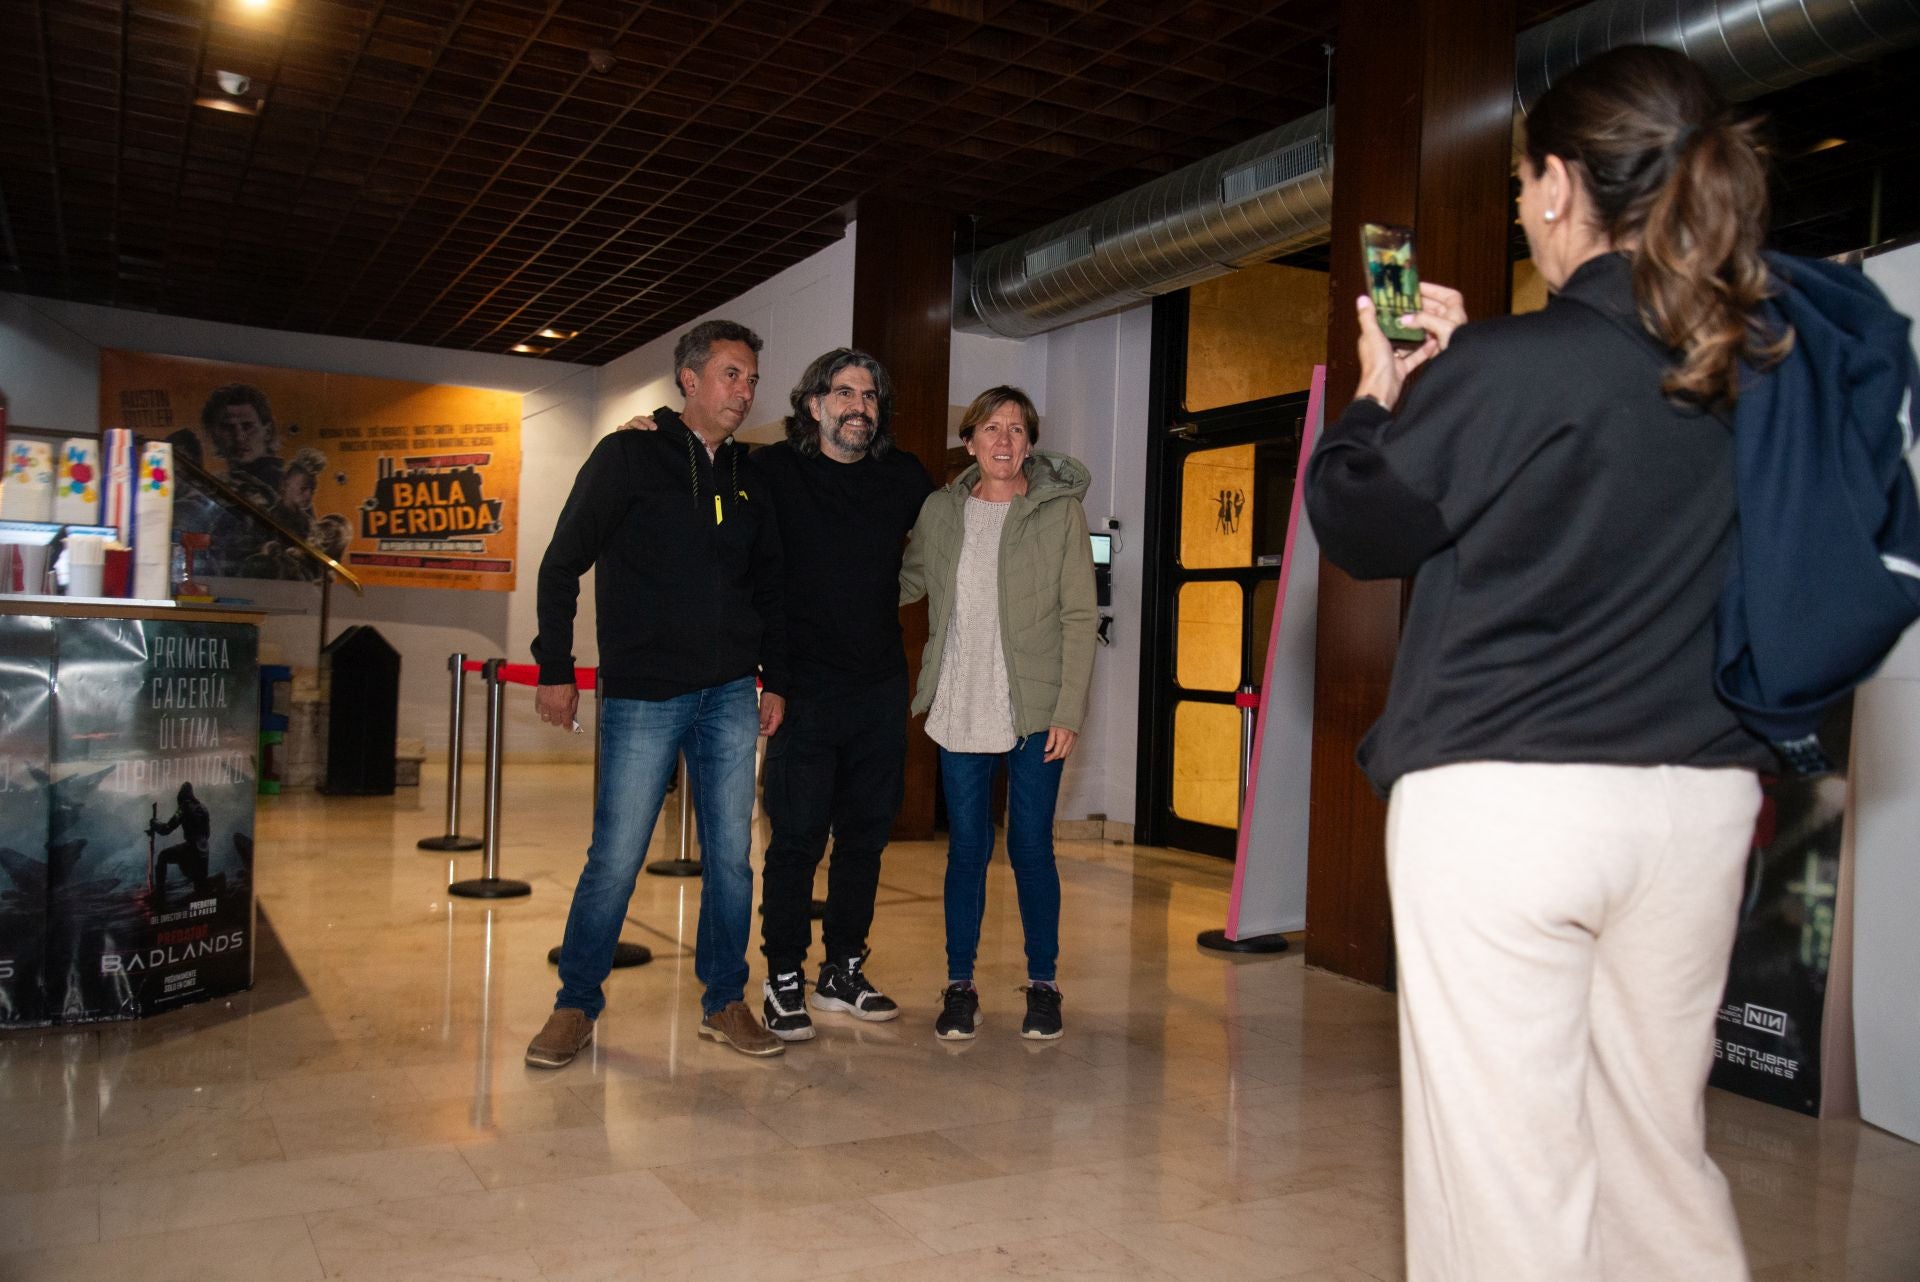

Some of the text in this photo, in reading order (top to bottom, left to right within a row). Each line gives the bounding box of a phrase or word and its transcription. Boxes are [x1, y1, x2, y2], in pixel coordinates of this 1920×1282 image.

[393, 479, 465, 508] BALA
[368, 502, 492, 535] PERDIDA
[153, 636, 229, 669] PRIMERA
[159, 713, 219, 750] ÚLTIMA
[101, 931, 243, 972] BADLANDS
[1726, 1042, 1799, 1071] OCTUBRE
[1728, 1053, 1746, 1066] EN
[1750, 1060, 1794, 1079] CINES
